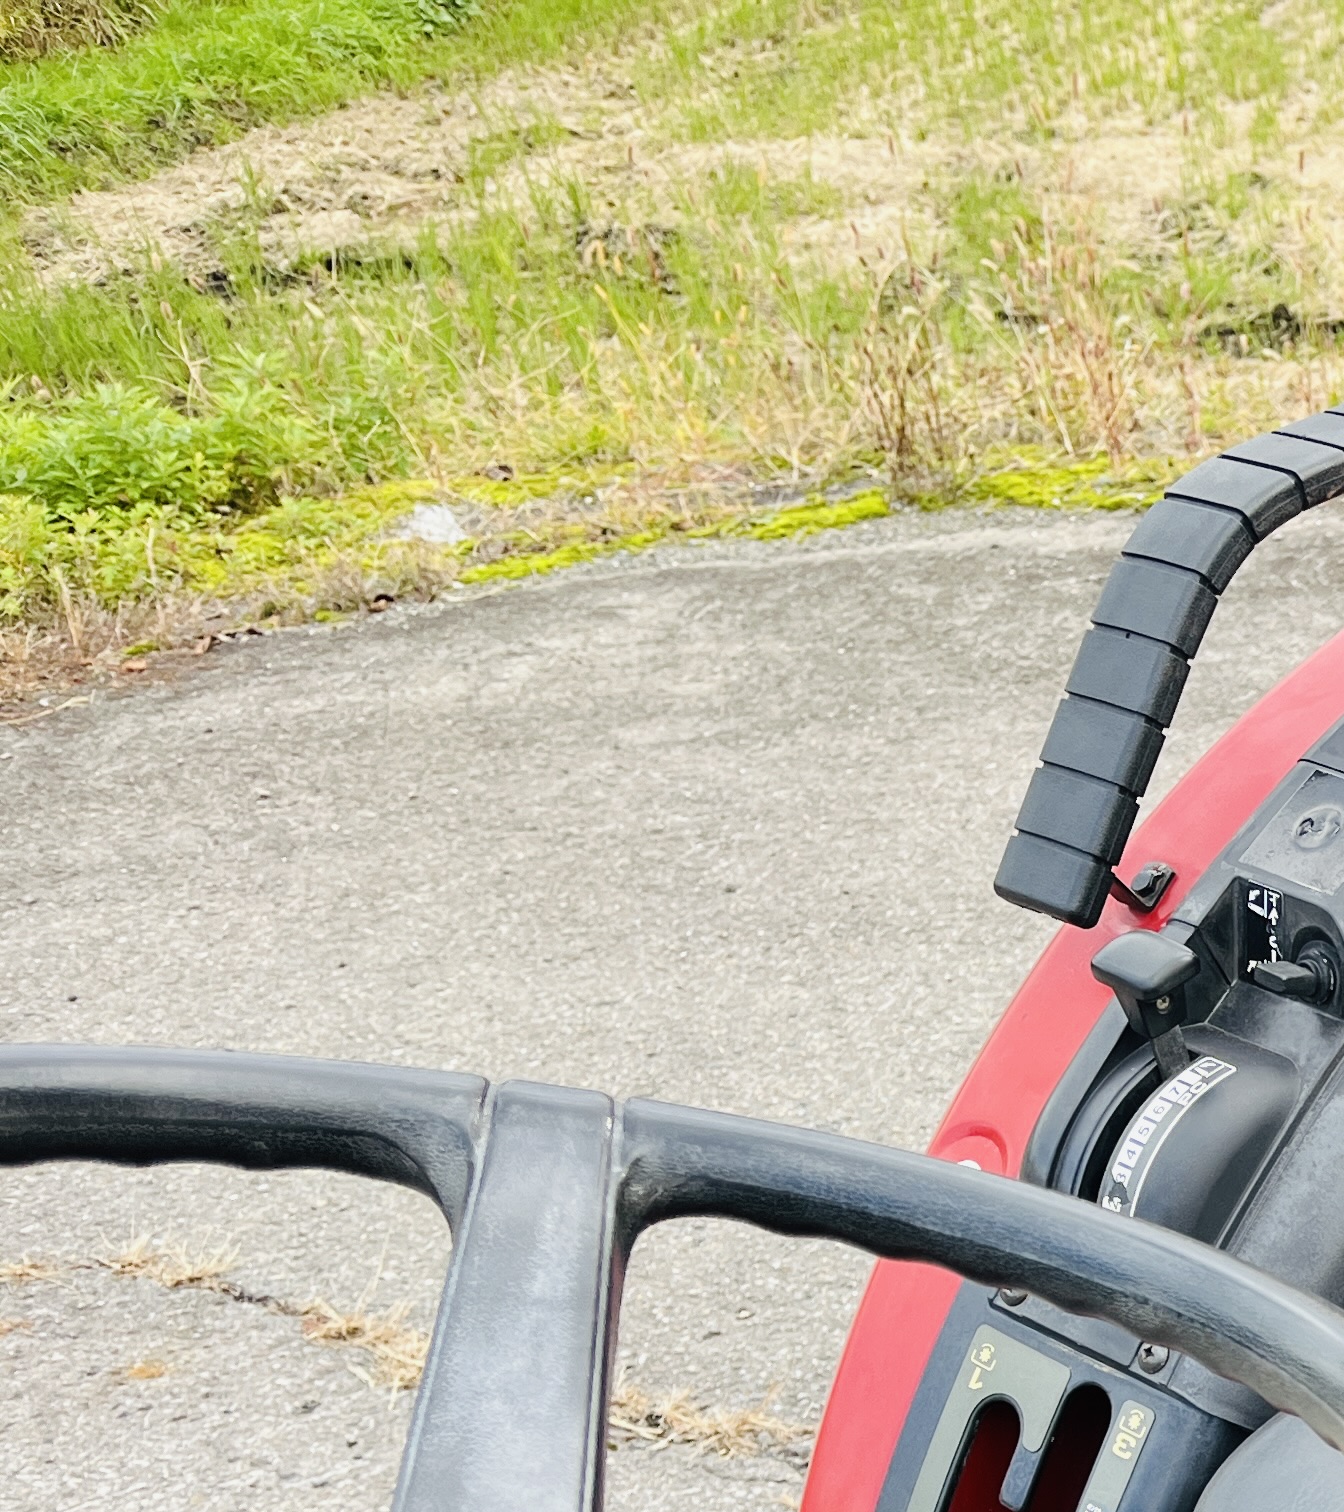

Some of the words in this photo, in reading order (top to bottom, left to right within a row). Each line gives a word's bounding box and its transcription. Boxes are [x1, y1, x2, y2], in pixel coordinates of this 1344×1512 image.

[1175, 1081, 1209, 1106] PC
[1126, 1149, 1137, 1160] 4
[1138, 1127, 1150, 1137] 5
[1153, 1106, 1165, 1115] 6
[1169, 1086, 1180, 1096] 7
[968, 1366, 983, 1390] 1
[1112, 1432, 1137, 1460] 3
